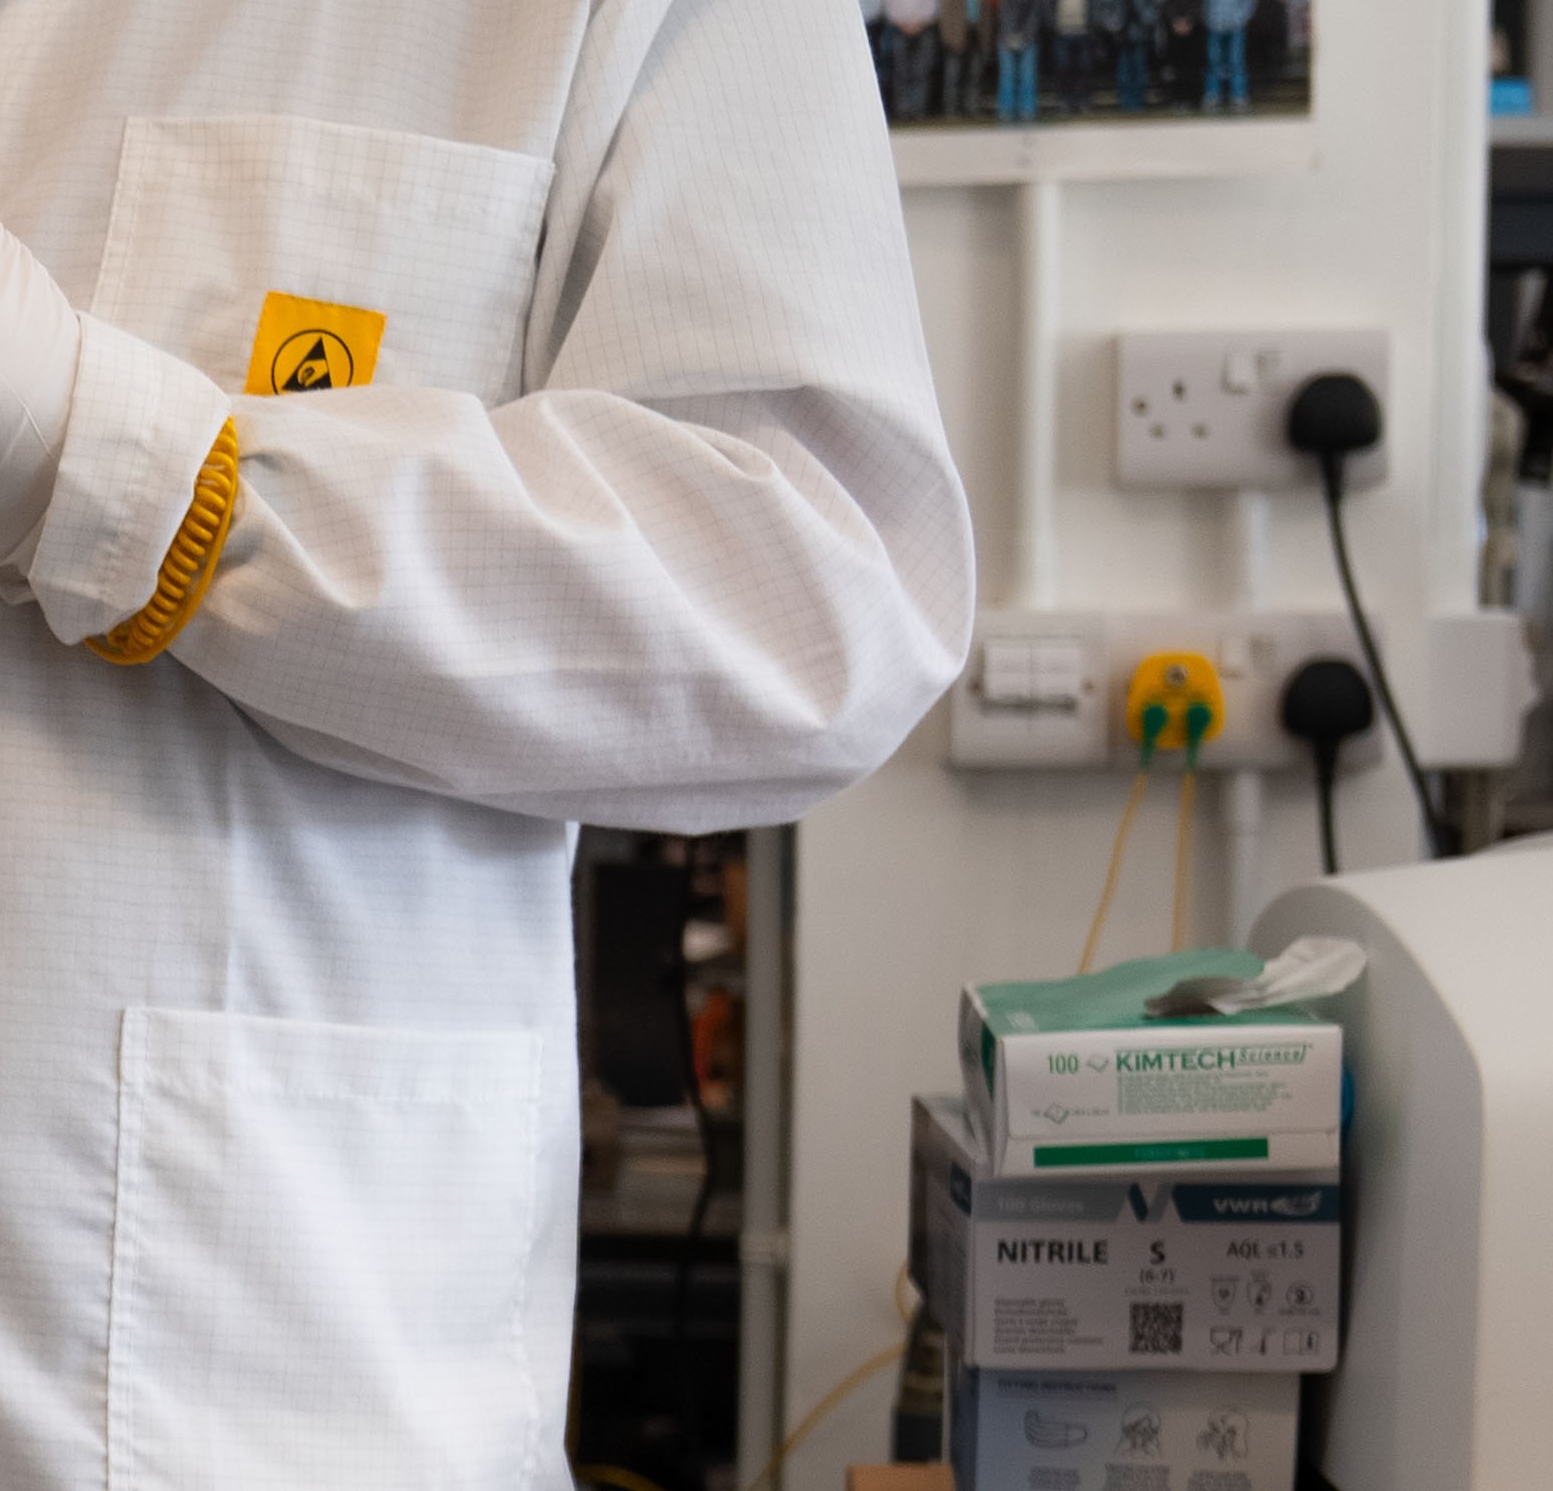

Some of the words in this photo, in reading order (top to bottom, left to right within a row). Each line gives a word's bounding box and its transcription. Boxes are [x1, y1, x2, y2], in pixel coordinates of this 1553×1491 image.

[1047, 1054, 1078, 1074] 100
[1115, 1049, 1237, 1072] KIMTECH
[1213, 1197, 1268, 1214] VWR
[997, 1239, 1109, 1264] NITRILE
[1149, 1240, 1166, 1264] S
[1226, 1241, 1260, 1260] AQL
